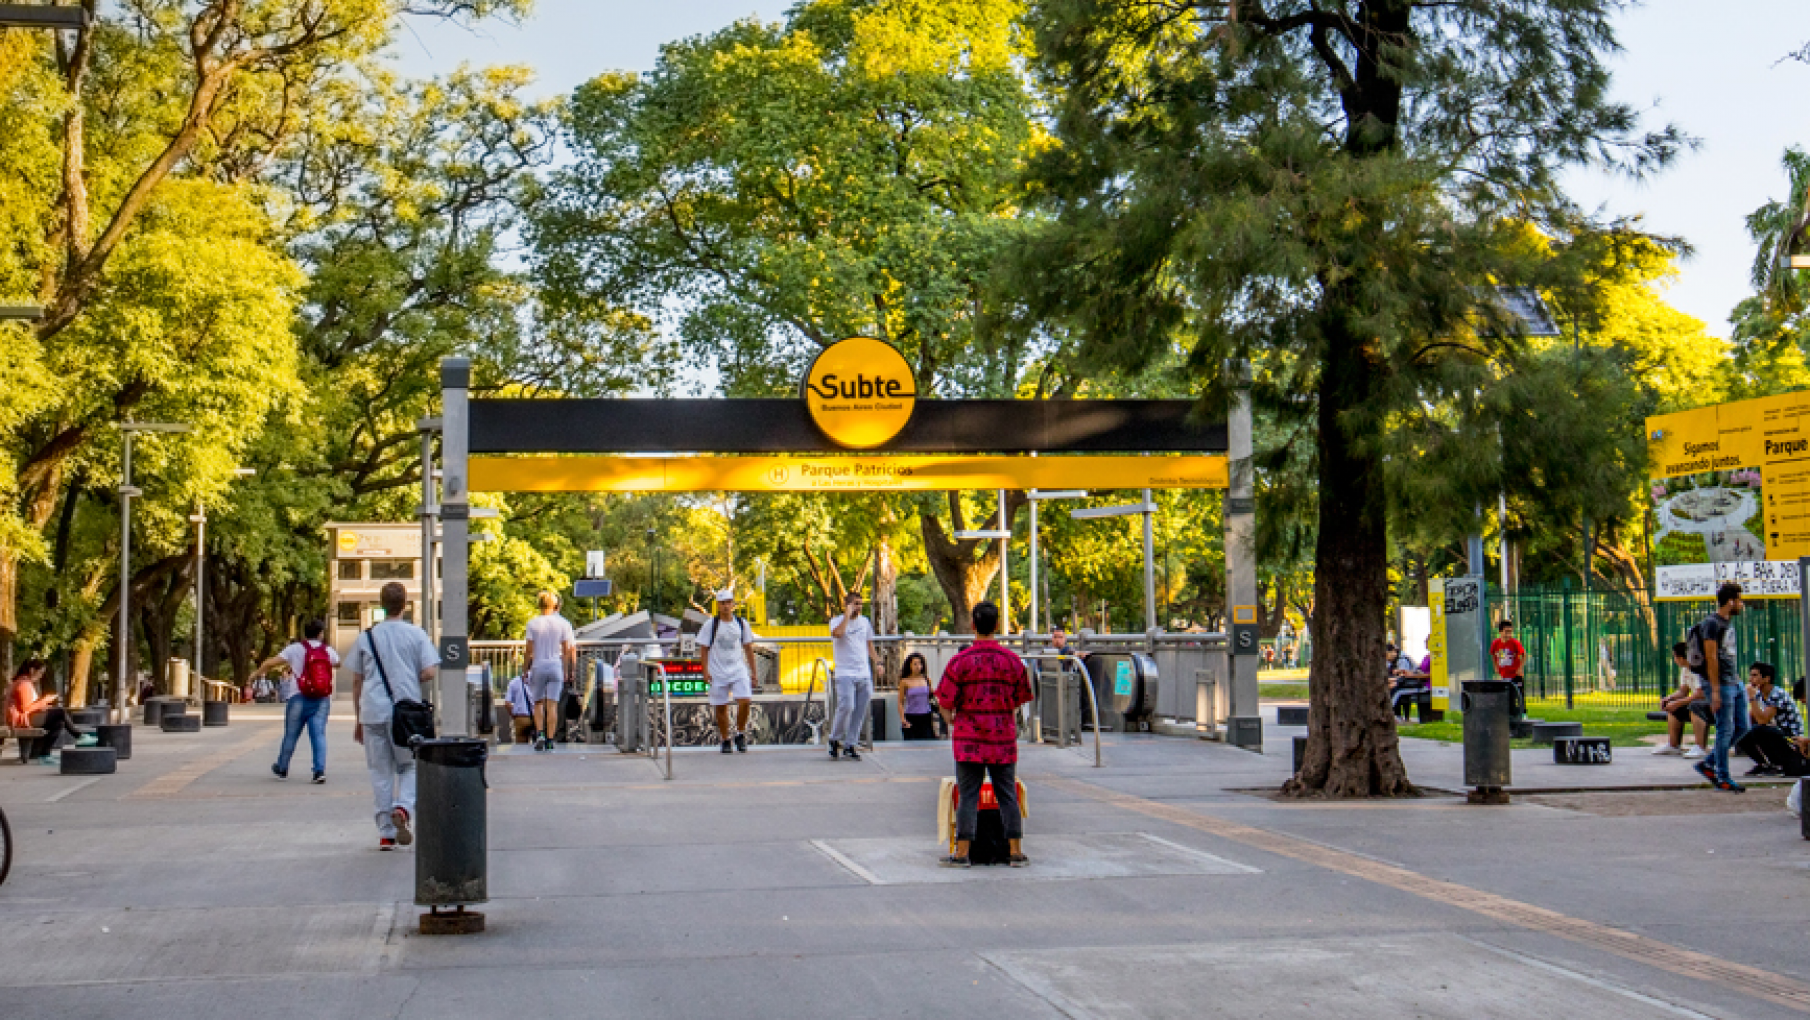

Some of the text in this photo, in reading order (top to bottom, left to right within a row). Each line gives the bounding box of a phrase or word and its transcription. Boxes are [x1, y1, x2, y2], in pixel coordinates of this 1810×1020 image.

[818, 373, 905, 399] Subte
[821, 404, 850, 412] Buenos
[875, 403, 902, 411] Ciudad
[1683, 440, 1719, 457] Sigamos
[1764, 438, 1809, 456] Parque
[774, 468, 784, 480] H
[801, 463, 913, 478] Parque Patricios
[1665, 457, 1710, 475] avanzando
[1239, 630, 1251, 647] S
[446, 643, 460, 661] S
